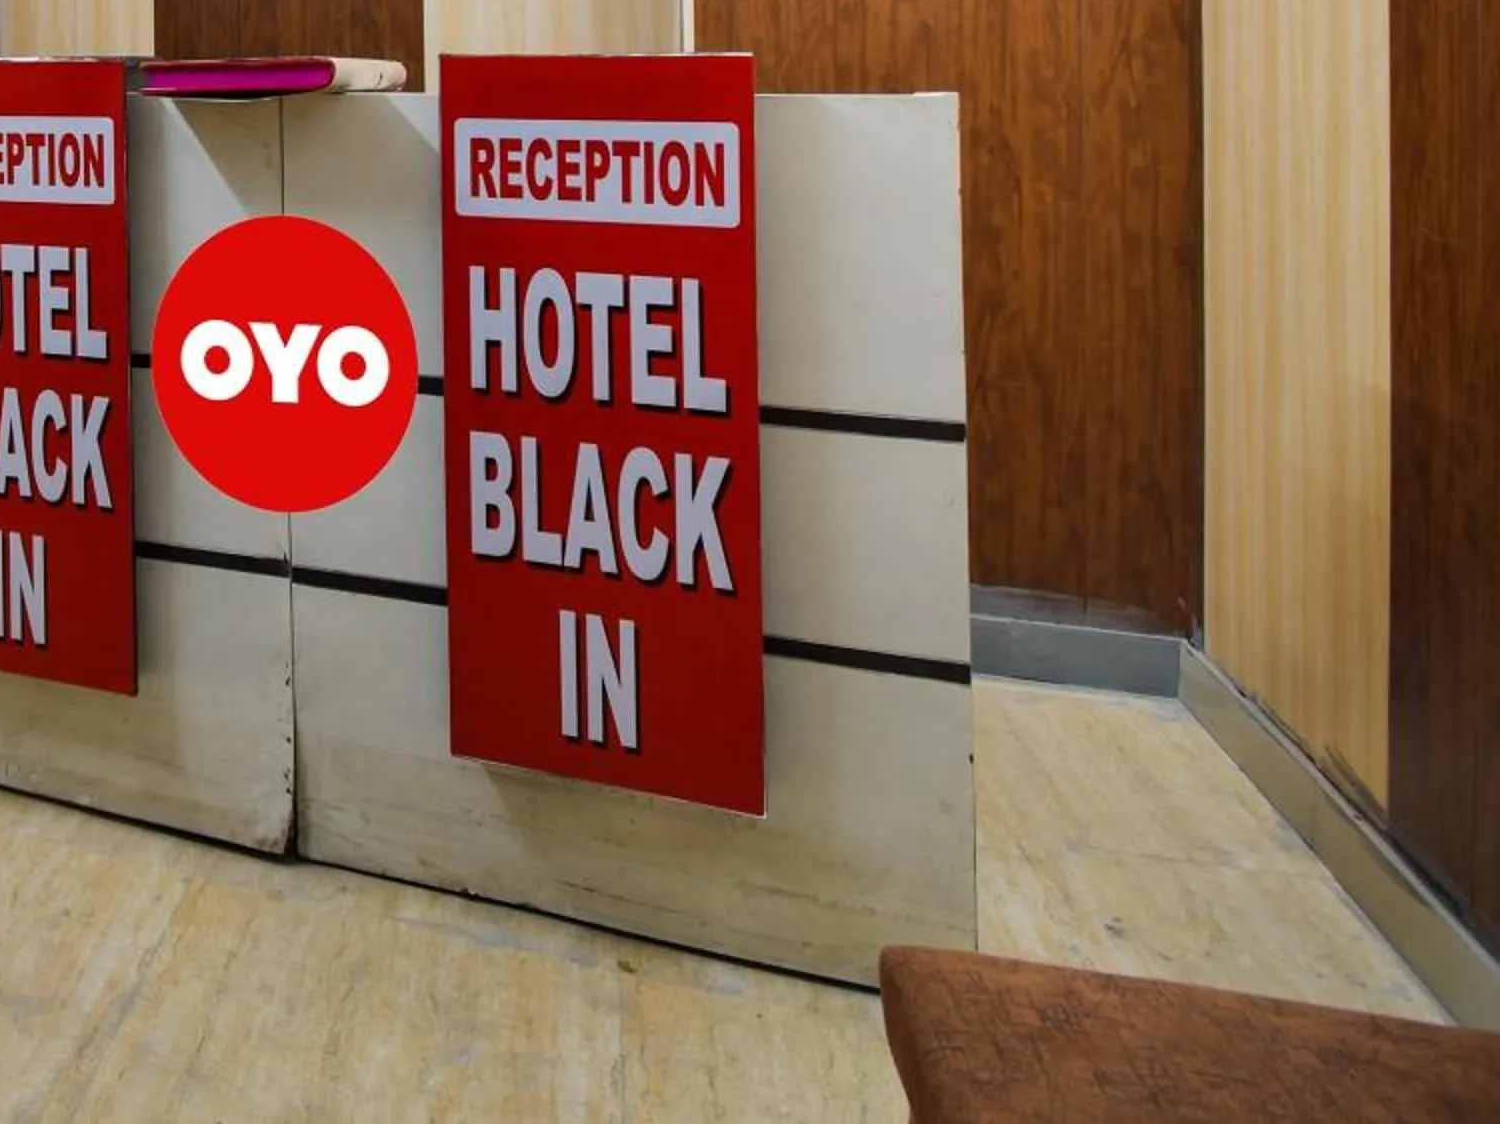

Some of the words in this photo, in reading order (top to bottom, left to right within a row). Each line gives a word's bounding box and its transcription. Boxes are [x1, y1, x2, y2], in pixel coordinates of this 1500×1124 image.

[470, 137, 725, 207] RECEPTION
[180, 319, 390, 407] OYO
[469, 265, 730, 414] HOTEL
[469, 430, 736, 593] BLACK
[559, 610, 640, 750] IN
